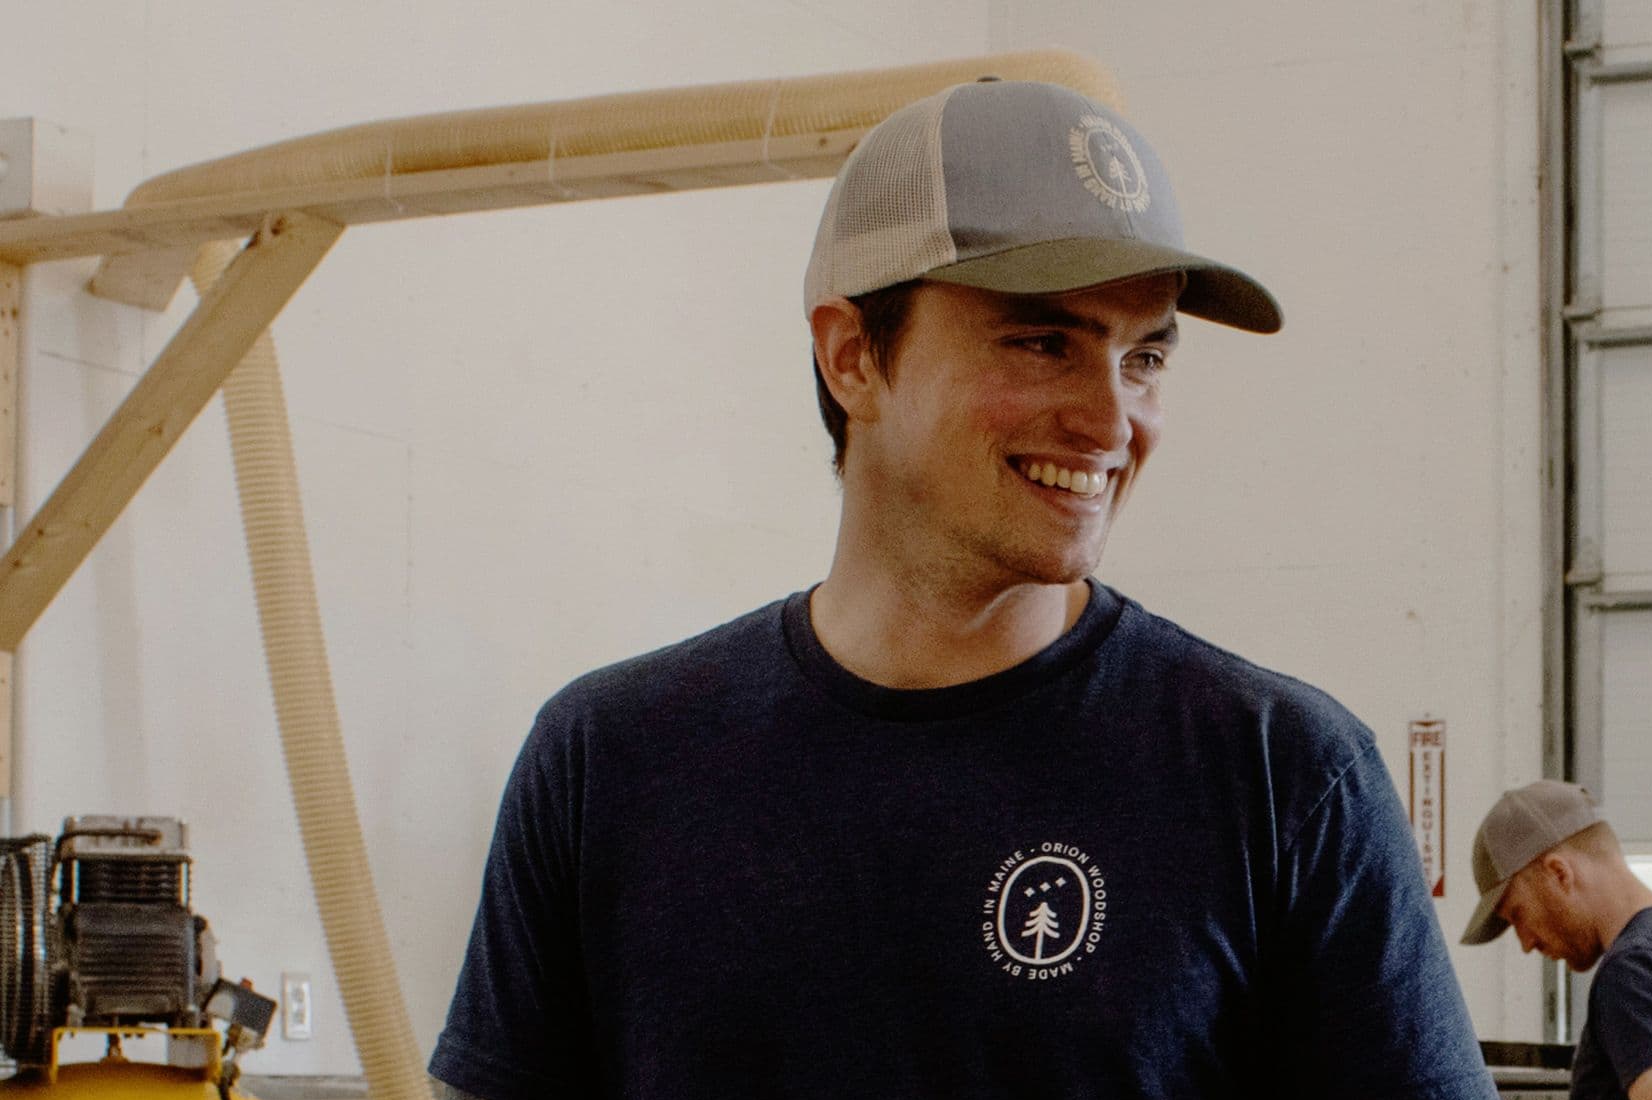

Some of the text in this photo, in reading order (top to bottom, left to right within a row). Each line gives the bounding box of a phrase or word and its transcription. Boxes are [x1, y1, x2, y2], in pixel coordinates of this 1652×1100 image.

[1411, 732, 1442, 747] FIRE
[1422, 751, 1434, 886] EXTINGUISHE
[982, 850, 1074, 980] MADE BY HAND IN MAINE
[1041, 842, 1107, 954] ORION WOODSHOP
